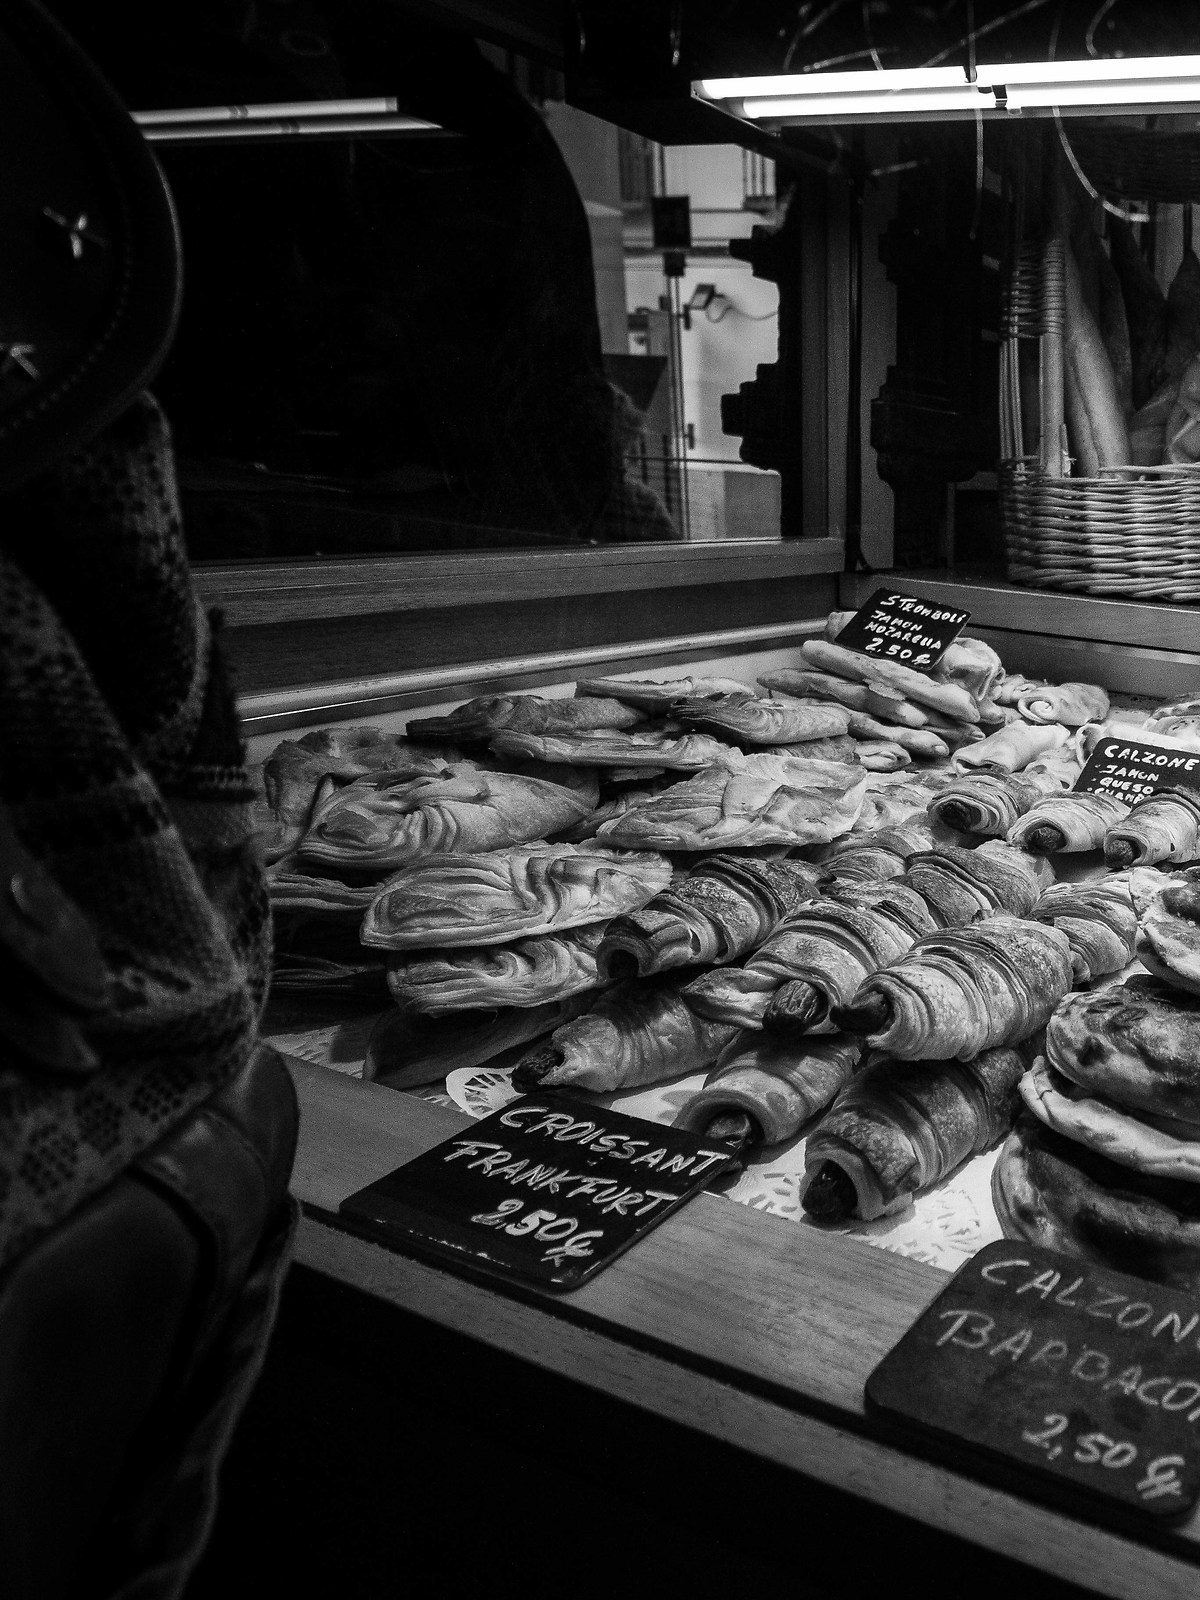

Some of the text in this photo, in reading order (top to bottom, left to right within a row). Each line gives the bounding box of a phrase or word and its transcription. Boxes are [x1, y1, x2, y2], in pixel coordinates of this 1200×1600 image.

[1104, 745, 1200, 771] CALZONE
[1099, 777, 1154, 795] QUESO
[500, 1106, 731, 1176] CROISSANT
[443, 1141, 680, 1217] FRANKFURT
